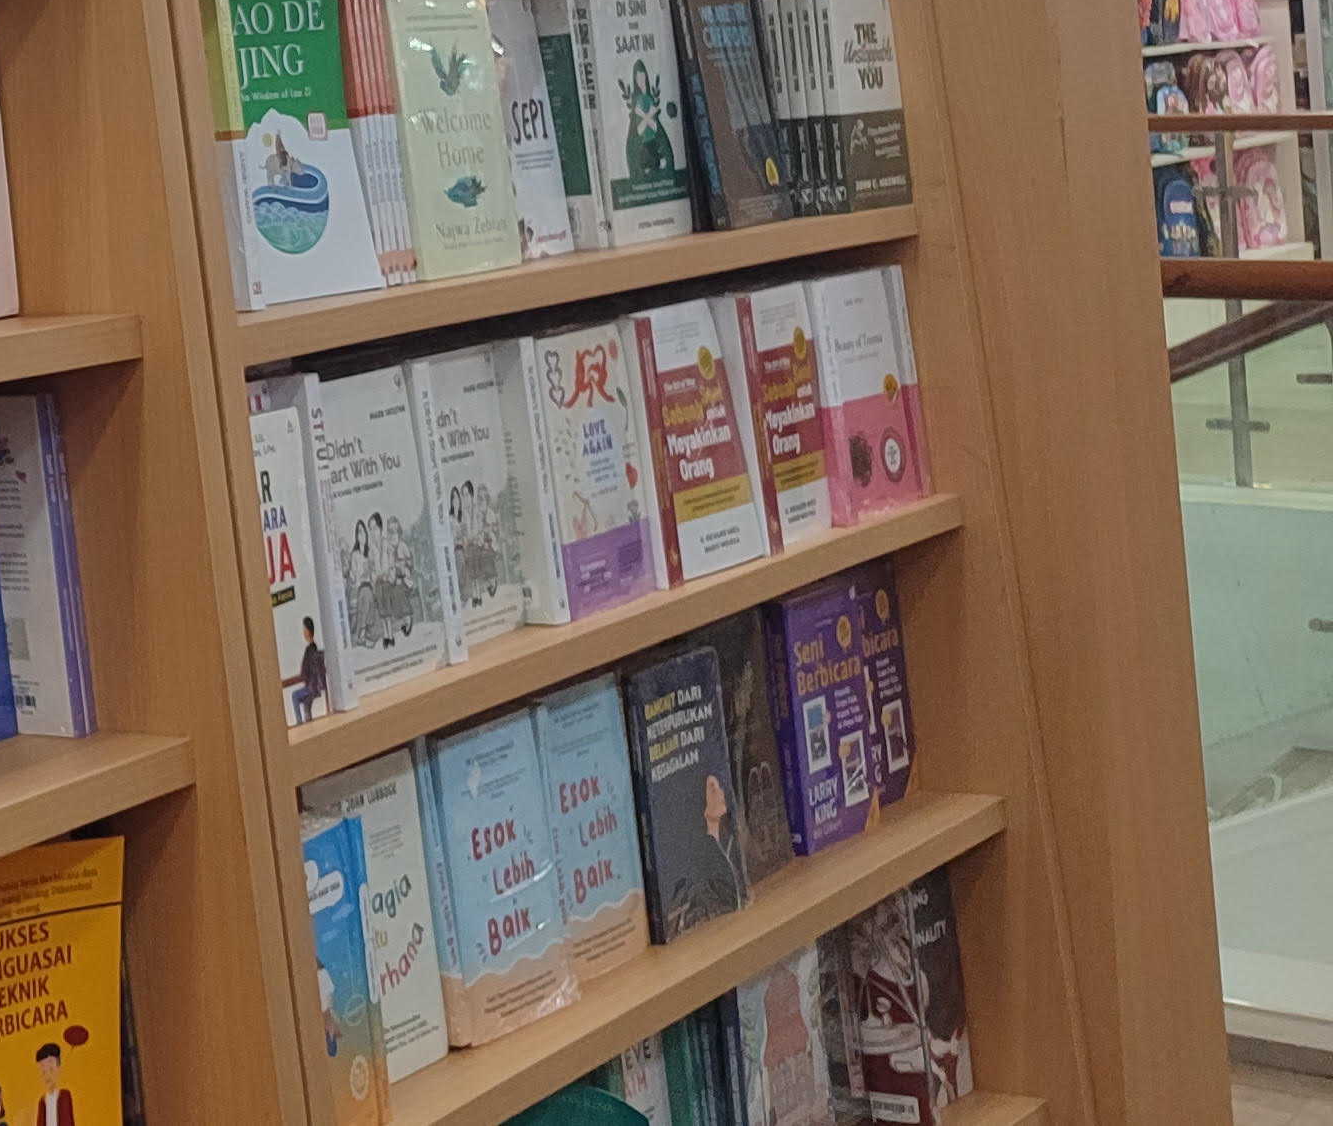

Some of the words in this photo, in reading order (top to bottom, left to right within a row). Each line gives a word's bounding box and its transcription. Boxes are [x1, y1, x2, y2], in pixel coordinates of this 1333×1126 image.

[854, 23, 878, 44] THE
[238, 43, 305, 89] JING
[857, 65, 884, 90] YOU
[419, 105, 493, 136] Welcome
[509, 97, 550, 145] SEPI
[436, 141, 485, 168] Home
[582, 433, 614, 457] AGAIN
[666, 424, 732, 458] Meyakinkan
[772, 433, 801, 456] Orang
[349, 457, 379, 481] With
[379, 453, 401, 473] You
[679, 457, 715, 482] Orang
[793, 637, 824, 666] Seni
[795, 655, 862, 697] Berbicara
[677, 685, 702, 706] DARI
[808, 776, 840, 807] LARRY
[813, 796, 839, 825] KING
[491, 850, 536, 895] Lebih
[486, 902, 532, 957] Baik
